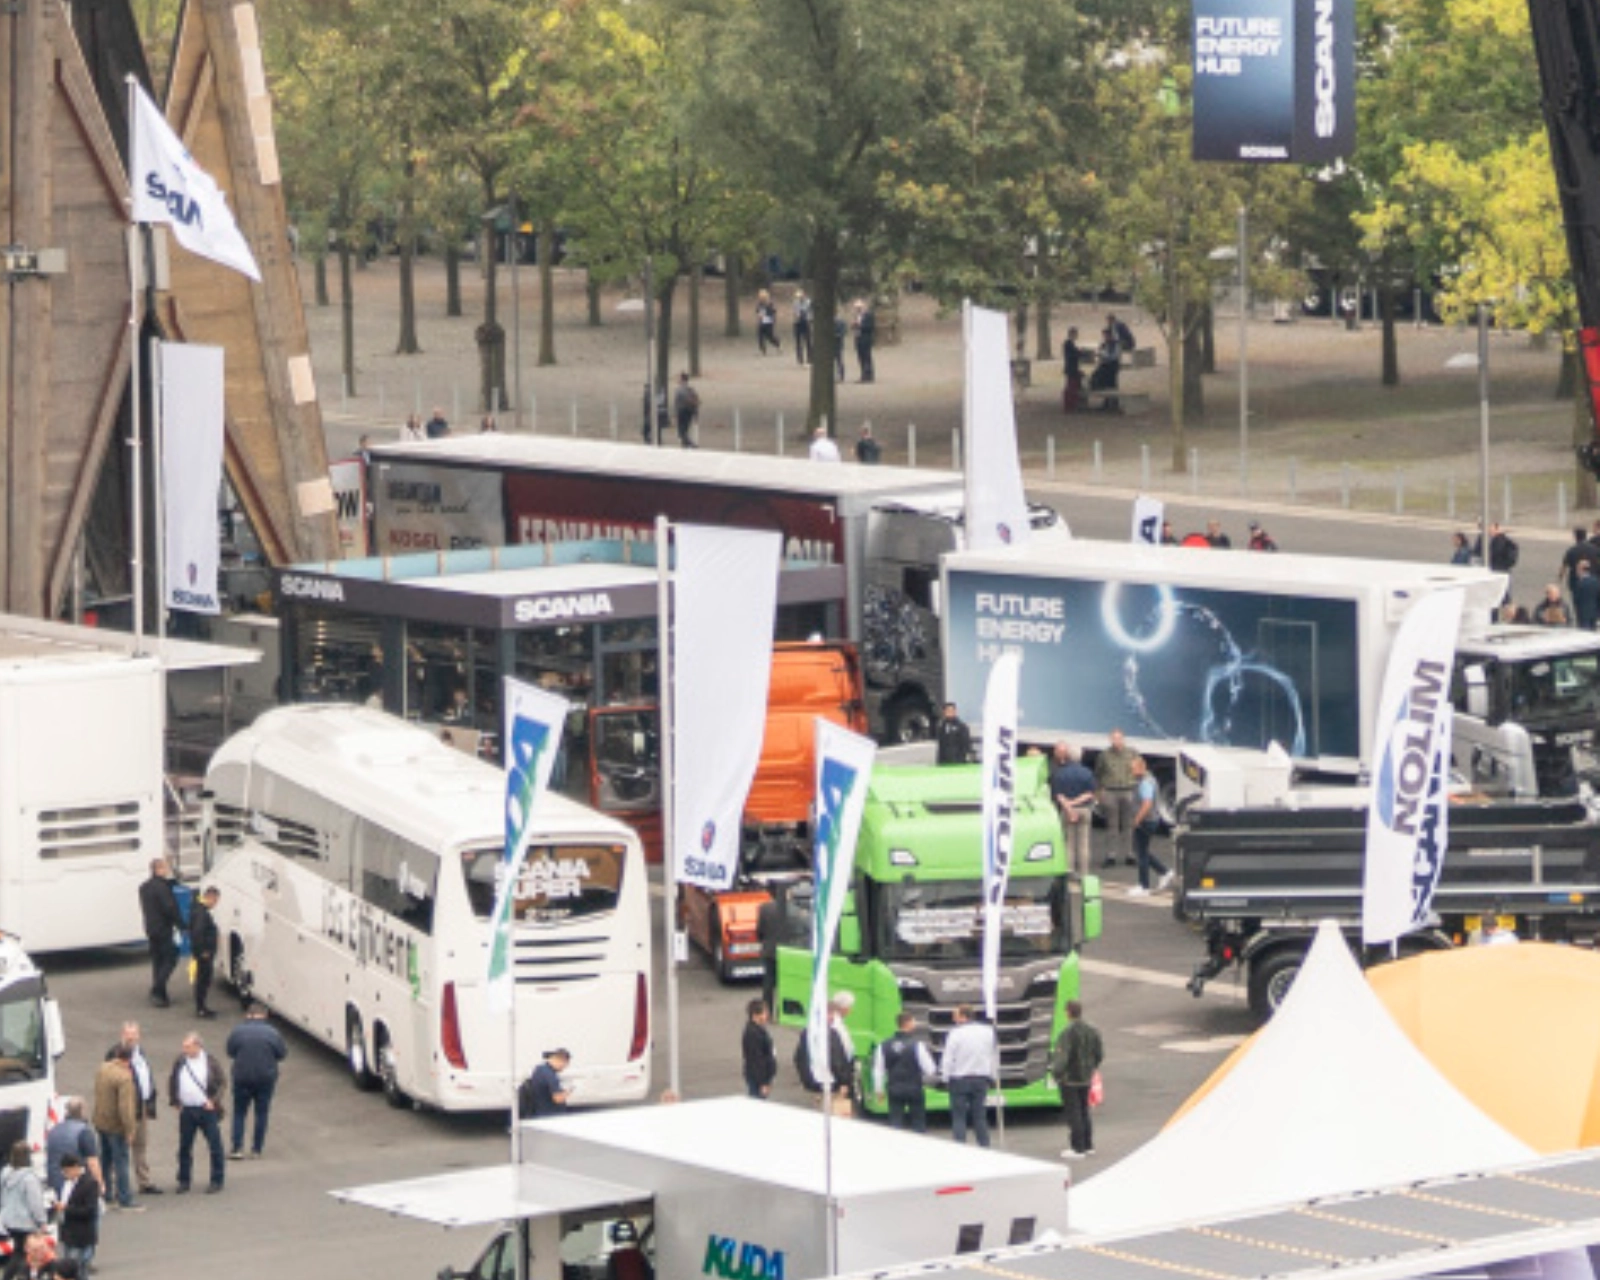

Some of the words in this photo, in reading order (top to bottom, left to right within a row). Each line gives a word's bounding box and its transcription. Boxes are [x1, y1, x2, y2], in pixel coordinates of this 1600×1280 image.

[1196, 17, 1281, 36] FUTURE
[1196, 37, 1282, 57] ENERGY
[1196, 57, 1241, 75] HUB
[281, 574, 345, 602] SCANIA
[514, 591, 613, 622] SCANIA
[976, 593, 1065, 619] FUTURE
[976, 618, 1065, 643] ENERGY
